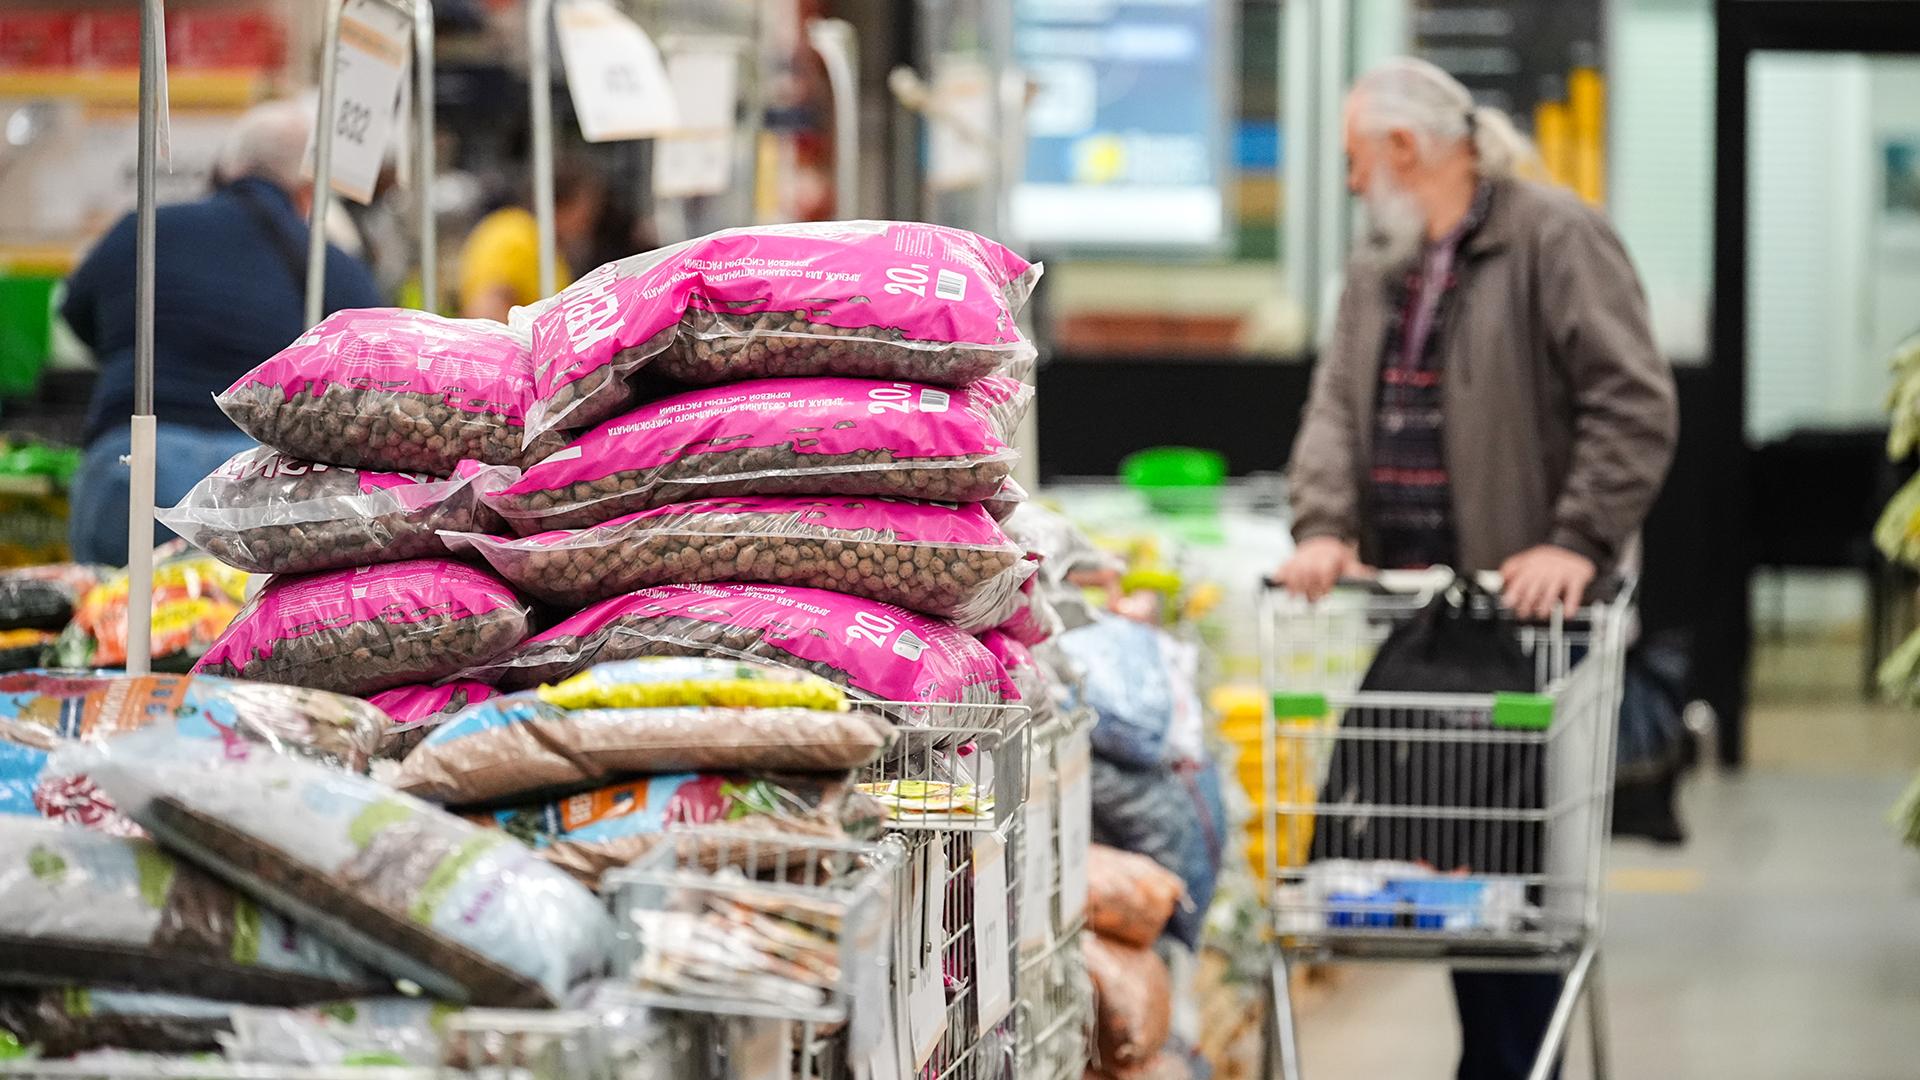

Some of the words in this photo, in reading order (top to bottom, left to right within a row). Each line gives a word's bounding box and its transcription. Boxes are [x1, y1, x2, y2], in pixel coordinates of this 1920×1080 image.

[683, 258, 722, 270] РАСТЕНИЙ
[724, 257, 765, 269] СИСТЕМЫ
[757, 268, 803, 278] СОЗДАНИЯ
[805, 270, 823, 280] ДЛЯ
[825, 271, 861, 282] ДРЕНАЖ
[704, 395, 747, 407] СИСТЕМЫ
[749, 391, 791, 401] КОРНЕВОЙ
[739, 401, 786, 412] СОЗДАНИЯ
[788, 399, 806, 408] ДЛЯ
[808, 397, 844, 408] ДРЕНАЖ
[659, 401, 702, 416] РАСТЕНИЙ
[675, 404, 738, 423] ОПТИМАЛЬНОГО
[607, 417, 673, 437] МИКРОКЛИМАТА
[776, 596, 796, 607] ДЛЯ
[795, 601, 831, 616] ДРЕНАЖ
